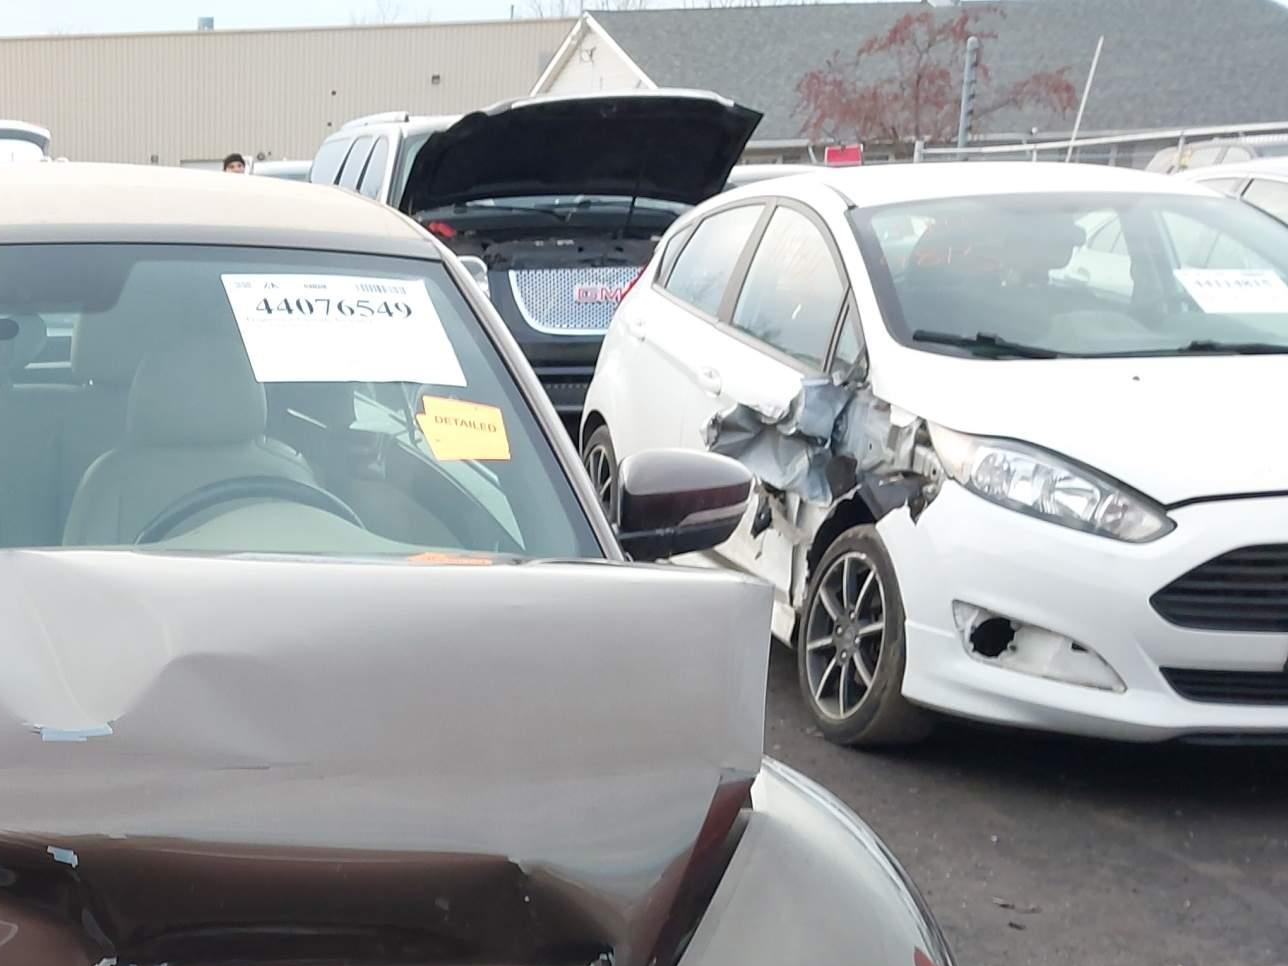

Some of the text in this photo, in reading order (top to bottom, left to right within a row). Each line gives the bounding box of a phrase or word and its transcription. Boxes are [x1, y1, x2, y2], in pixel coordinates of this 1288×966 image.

[575, 286, 623, 303] GM
[255, 297, 413, 319] 44076549
[434, 414, 497, 433] DETAILED
